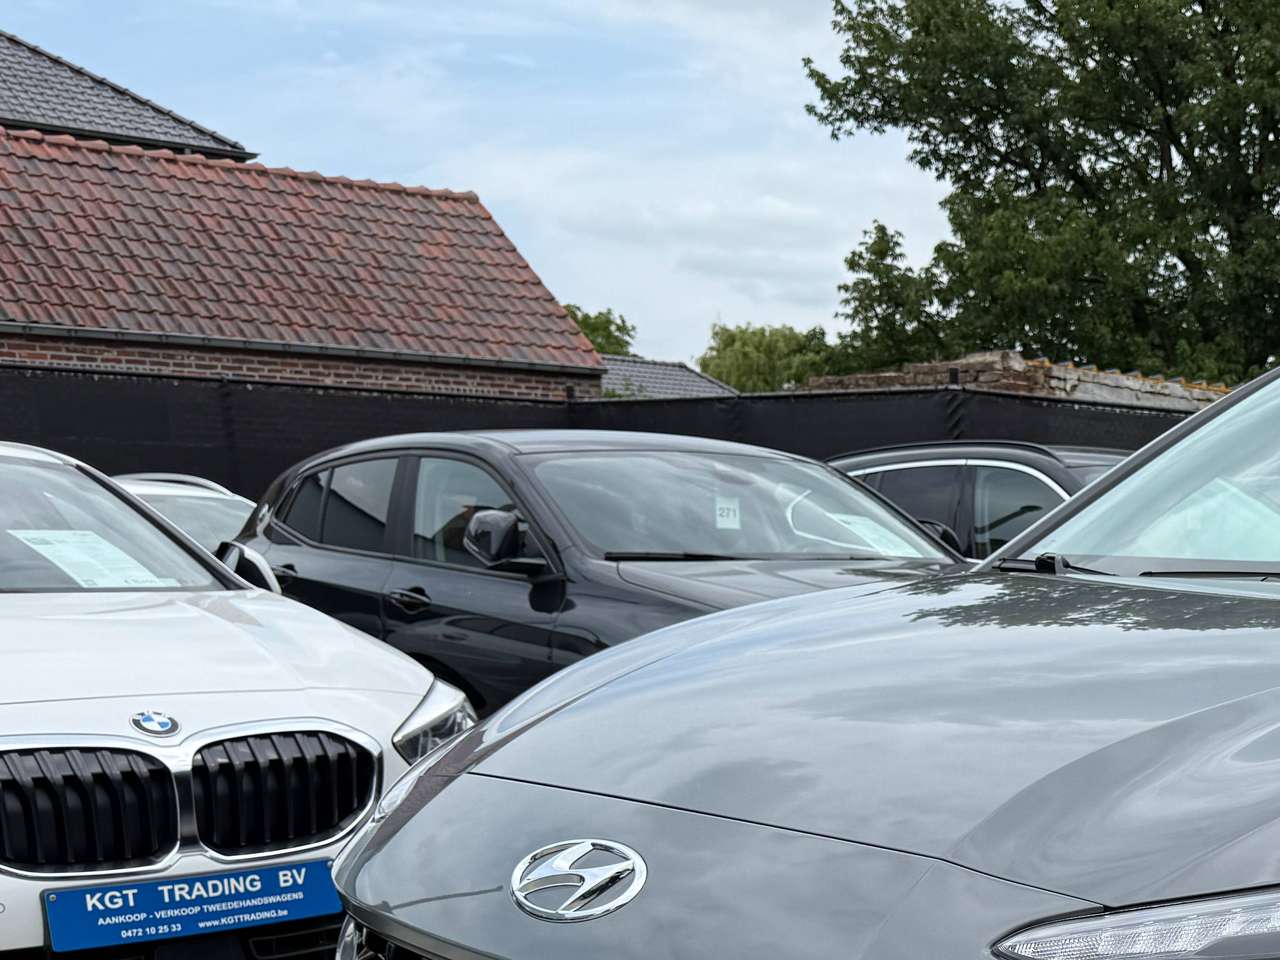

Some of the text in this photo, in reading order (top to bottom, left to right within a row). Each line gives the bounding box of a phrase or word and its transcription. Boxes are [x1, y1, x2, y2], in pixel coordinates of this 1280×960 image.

[718, 506, 738, 519] 271
[85, 867, 306, 912] KGT TRADING BV
[97, 912, 148, 926] AANKOOP
[154, 905, 201, 920] VERKOOP
[202, 891, 304, 913] TWEEDEHANDSWAGENS
[121, 908, 288, 939] 0472 10 25 33 www.KGTTRADING.be
